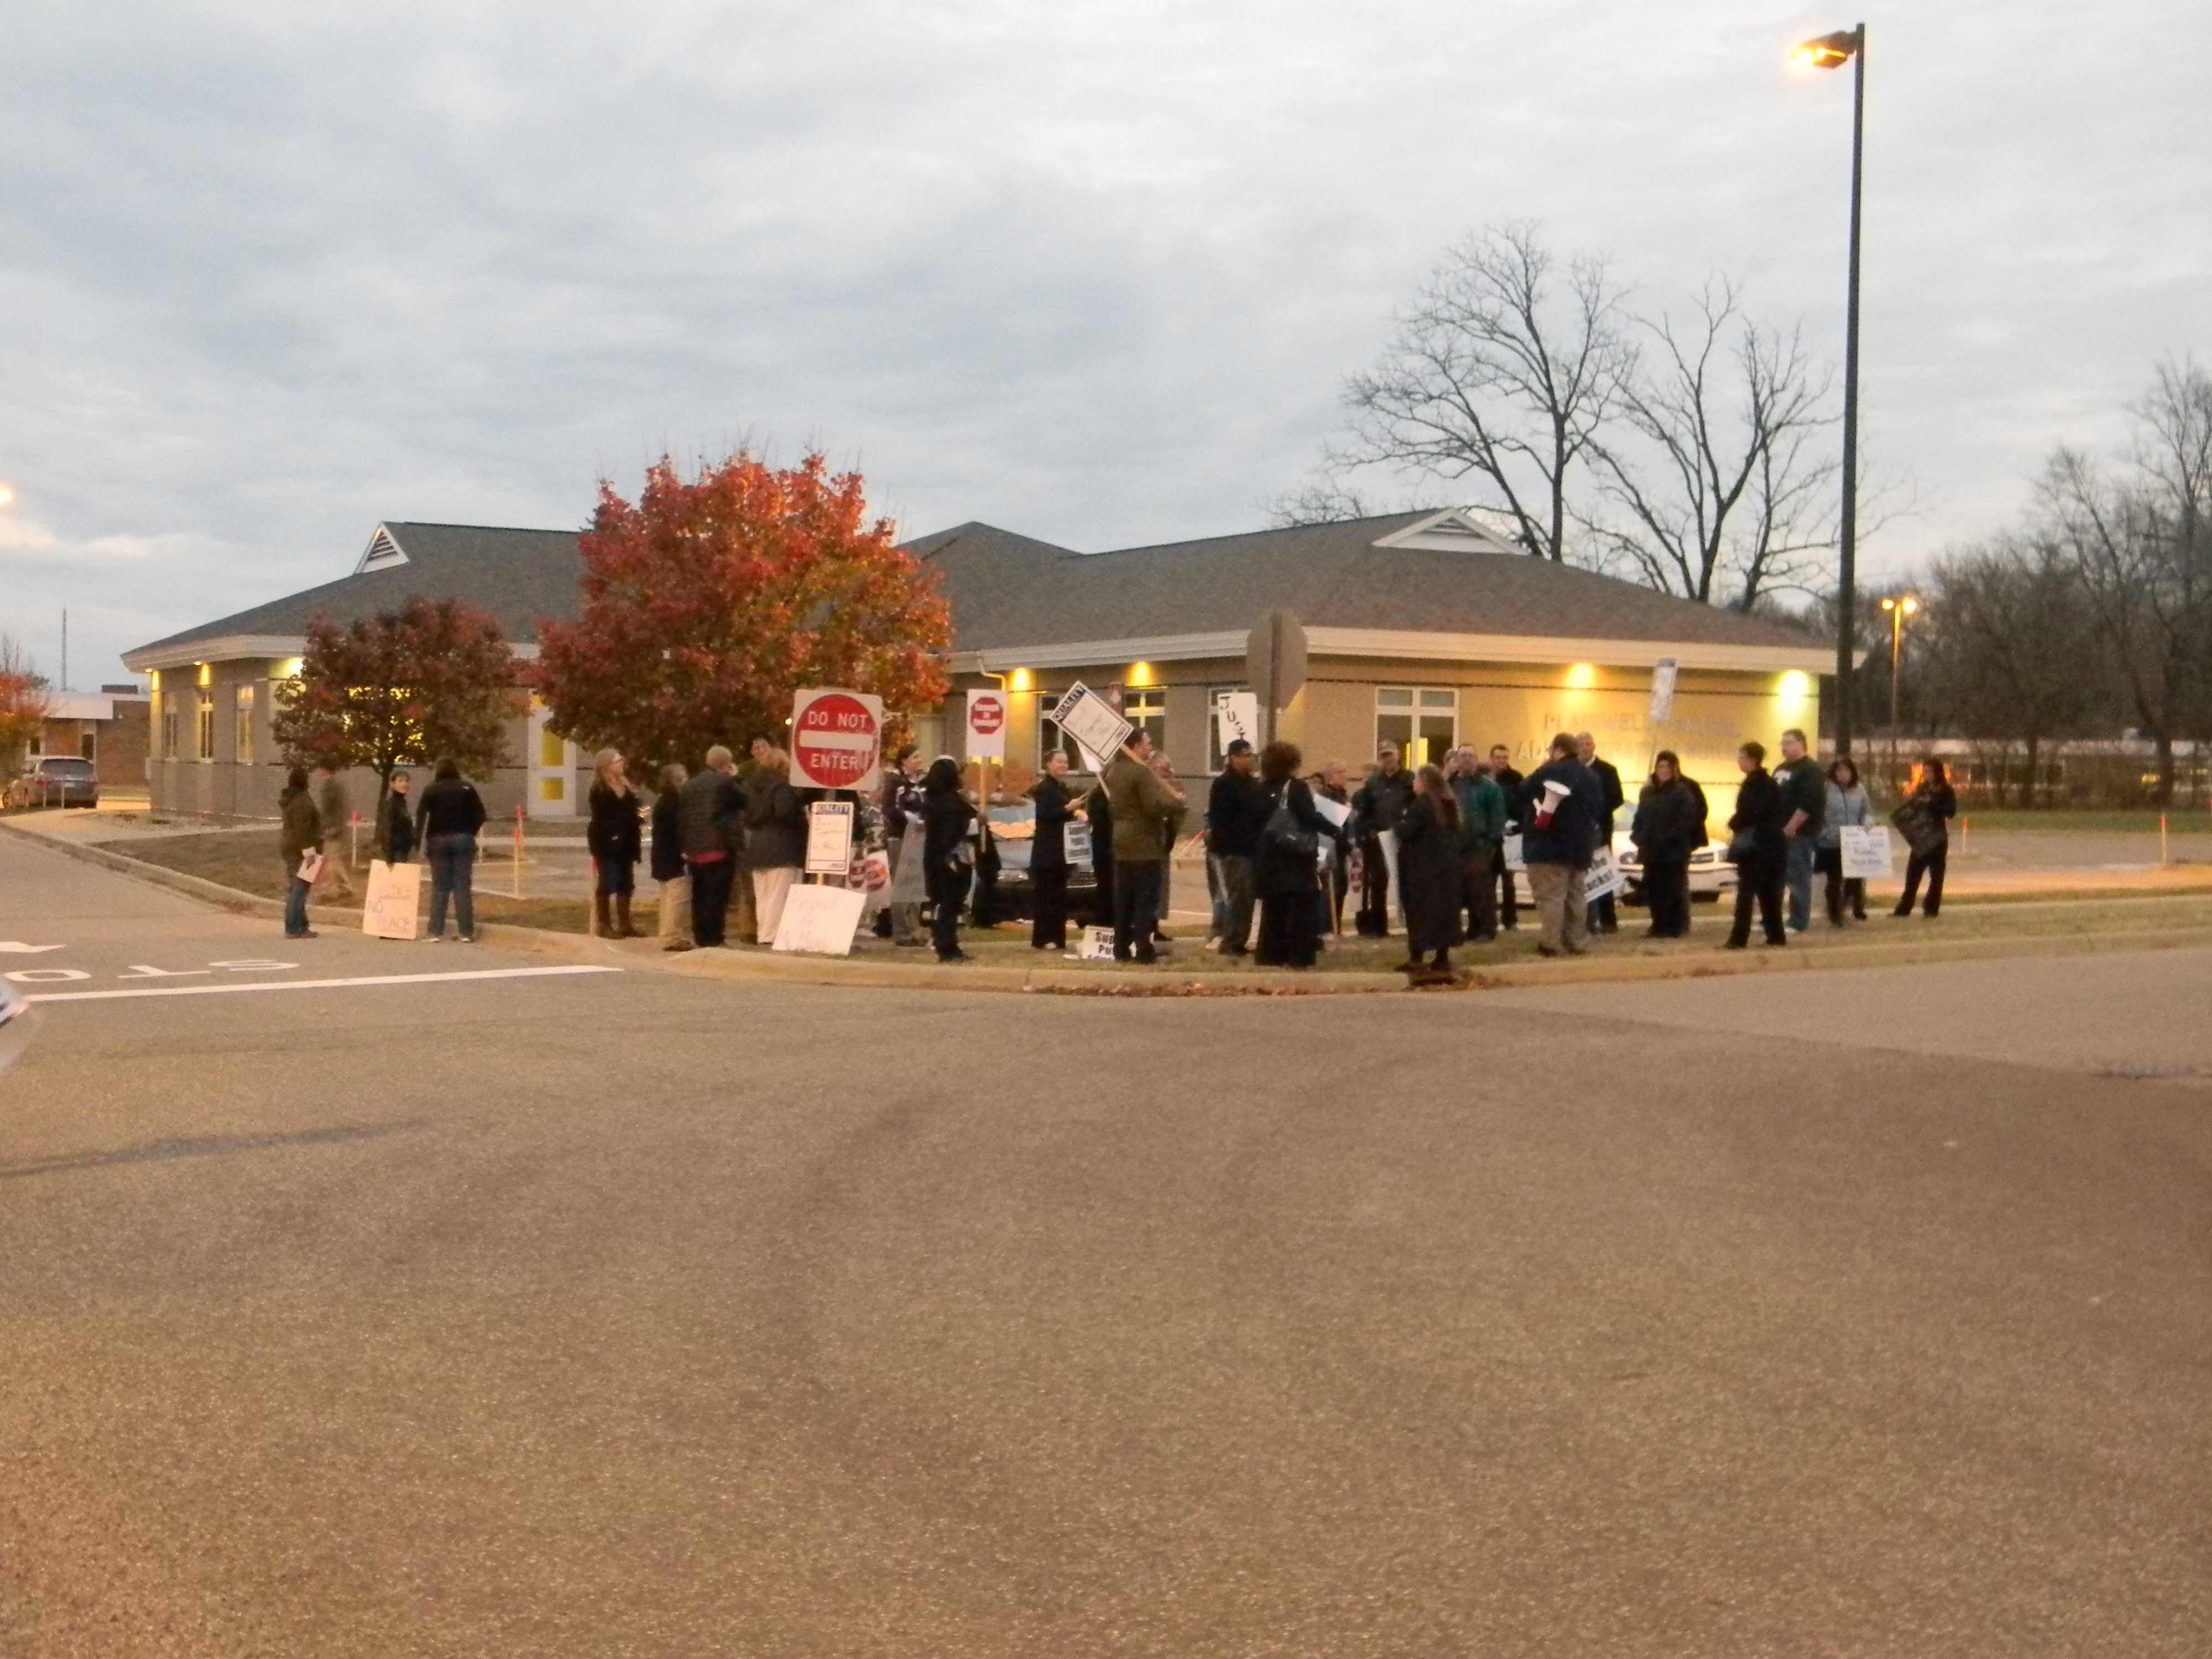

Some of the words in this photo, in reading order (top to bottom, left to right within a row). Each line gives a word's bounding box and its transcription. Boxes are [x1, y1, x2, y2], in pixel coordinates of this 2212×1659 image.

[807, 711, 828, 726] DO
[837, 712, 867, 728] NOT
[811, 753, 858, 770] ENTER
